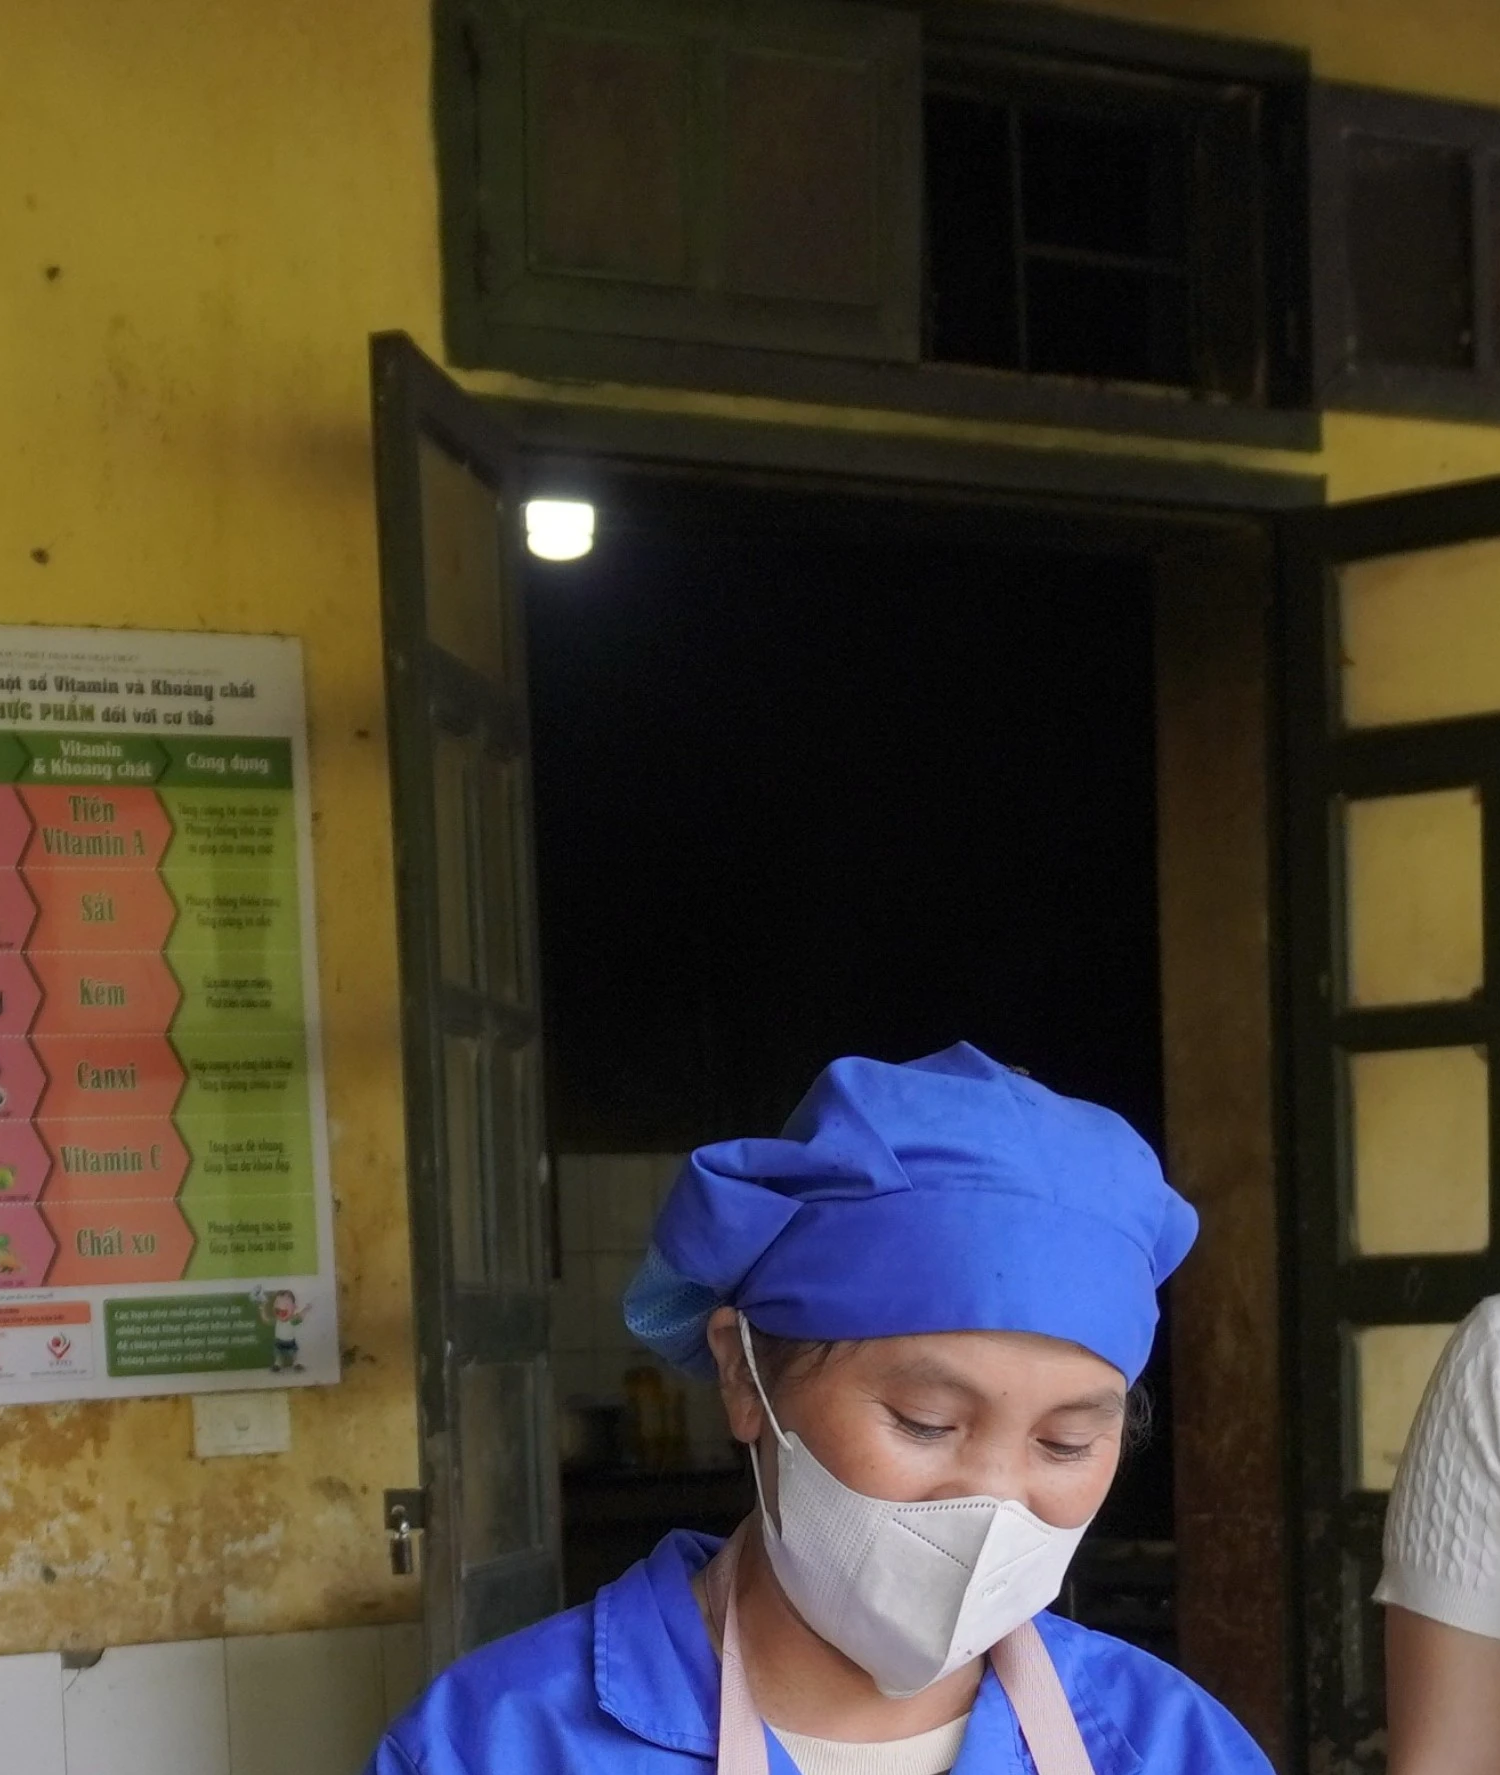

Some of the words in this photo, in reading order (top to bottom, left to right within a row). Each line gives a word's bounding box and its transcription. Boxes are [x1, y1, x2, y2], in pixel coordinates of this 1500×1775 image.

[29, 671, 48, 692] số
[53, 674, 119, 695] Vitamin
[126, 676, 145, 696] và
[60, 739, 124, 758] Vitamin
[230, 754, 270, 775] dụng
[42, 827, 126, 857] Vitamin
[133, 830, 147, 856] A
[77, 1060, 137, 1090] Canxi
[60, 1146, 144, 1173] Vitamin
[151, 1144, 162, 1172] C
